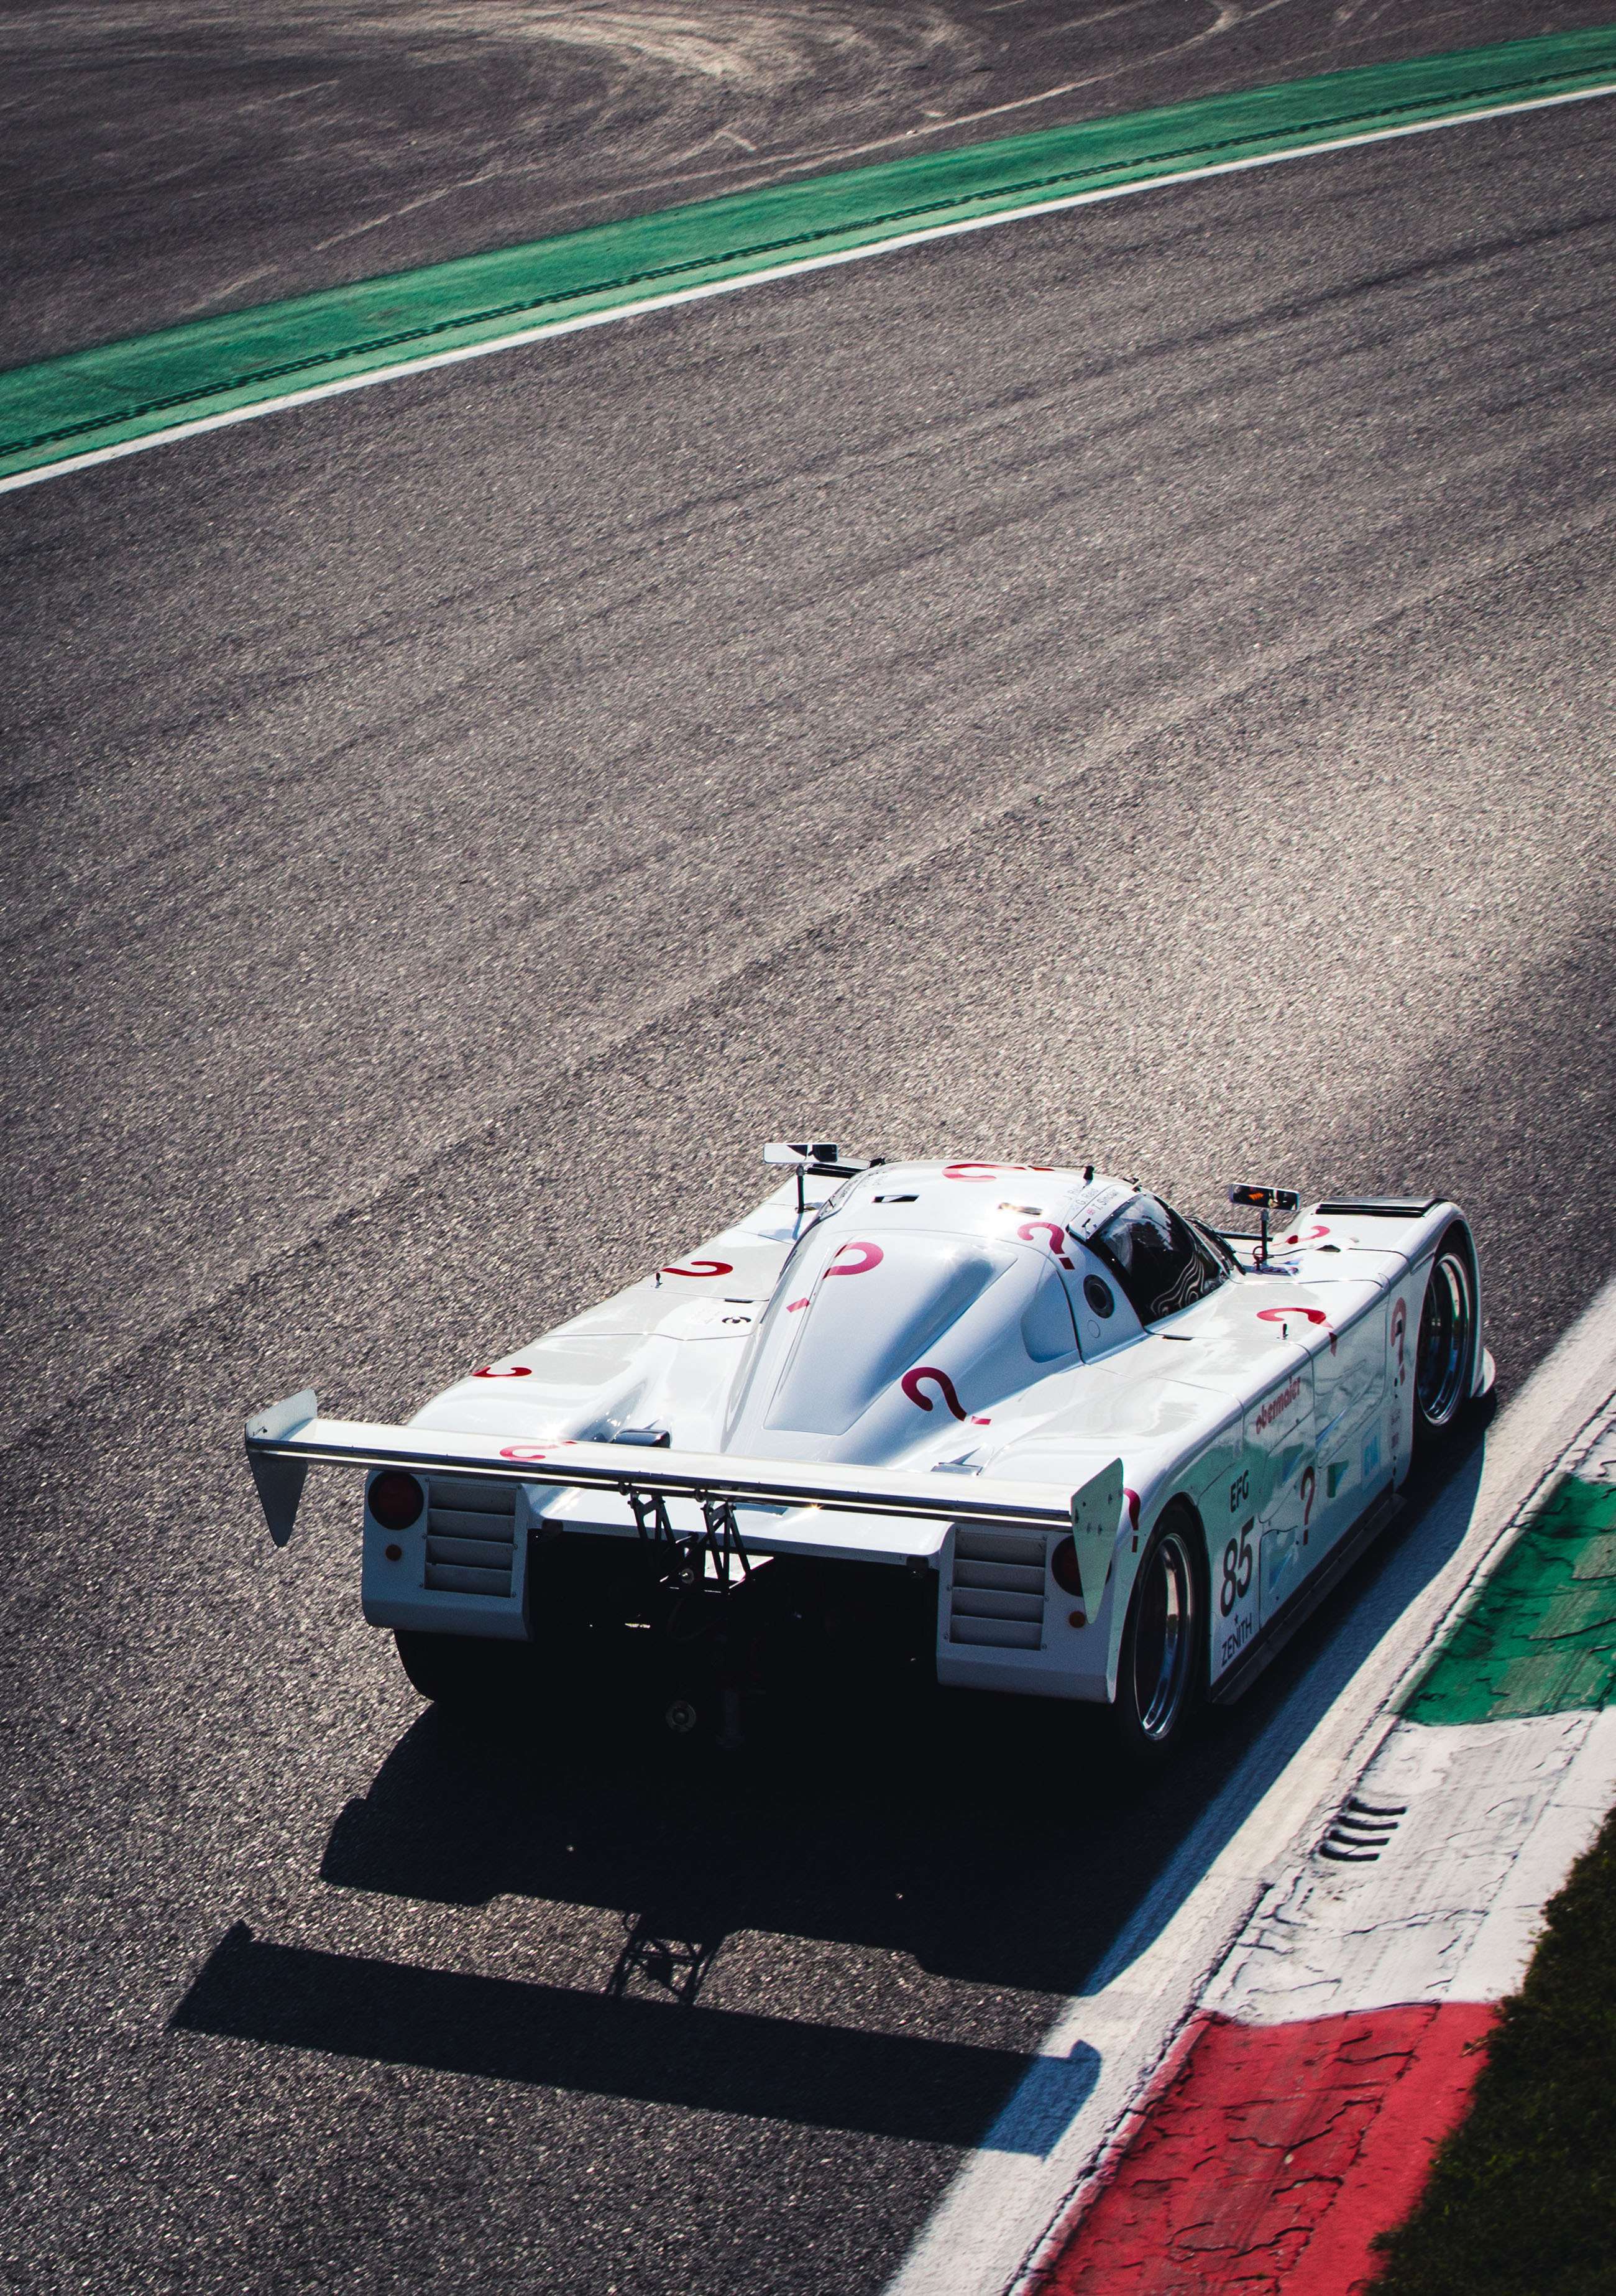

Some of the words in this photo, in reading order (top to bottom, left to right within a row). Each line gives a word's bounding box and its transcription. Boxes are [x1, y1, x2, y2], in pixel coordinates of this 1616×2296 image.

[1230, 1469, 1249, 1513] EFG
[1220, 1515, 1254, 1617] 85
[1221, 1612, 1252, 1667] ZENITH
